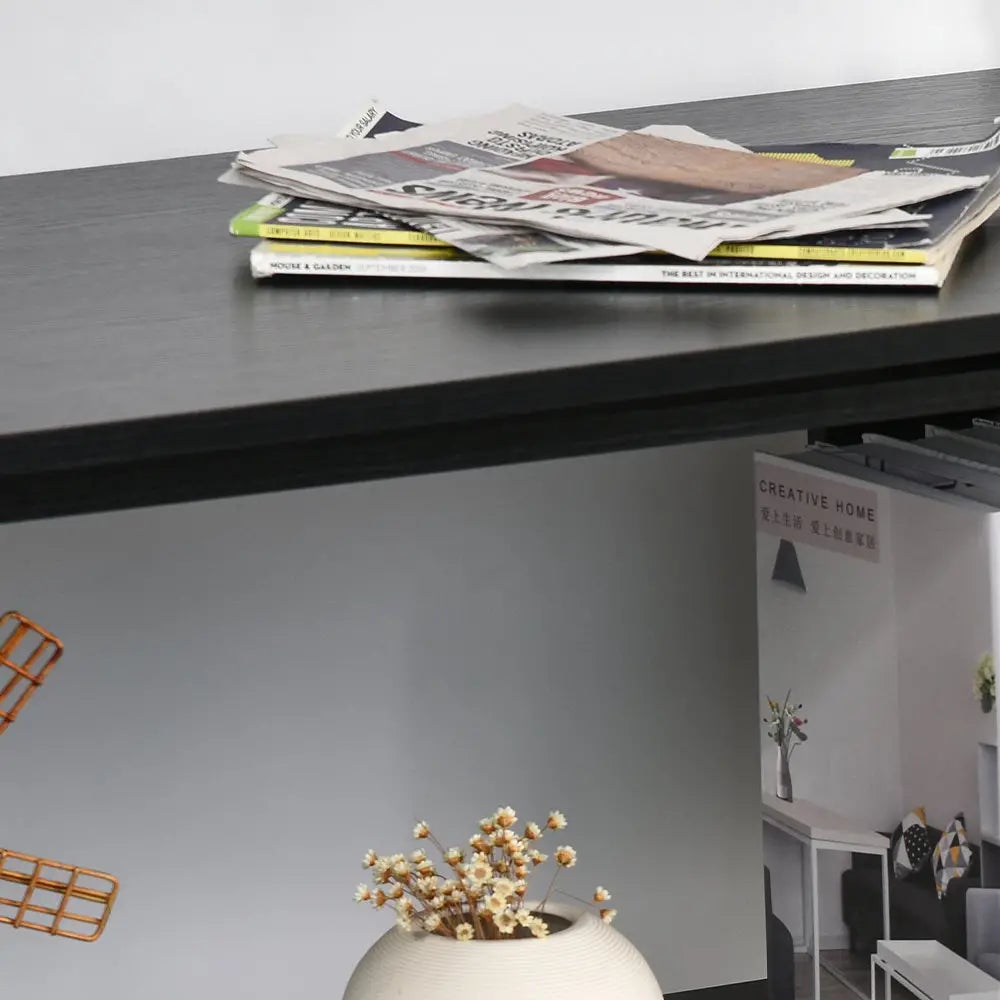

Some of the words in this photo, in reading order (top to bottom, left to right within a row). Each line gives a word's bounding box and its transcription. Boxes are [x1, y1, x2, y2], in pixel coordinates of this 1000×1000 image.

[661, 270, 679, 278] THE
[759, 480, 829, 510] CREATIVE
[836, 500, 876, 522] HOME
